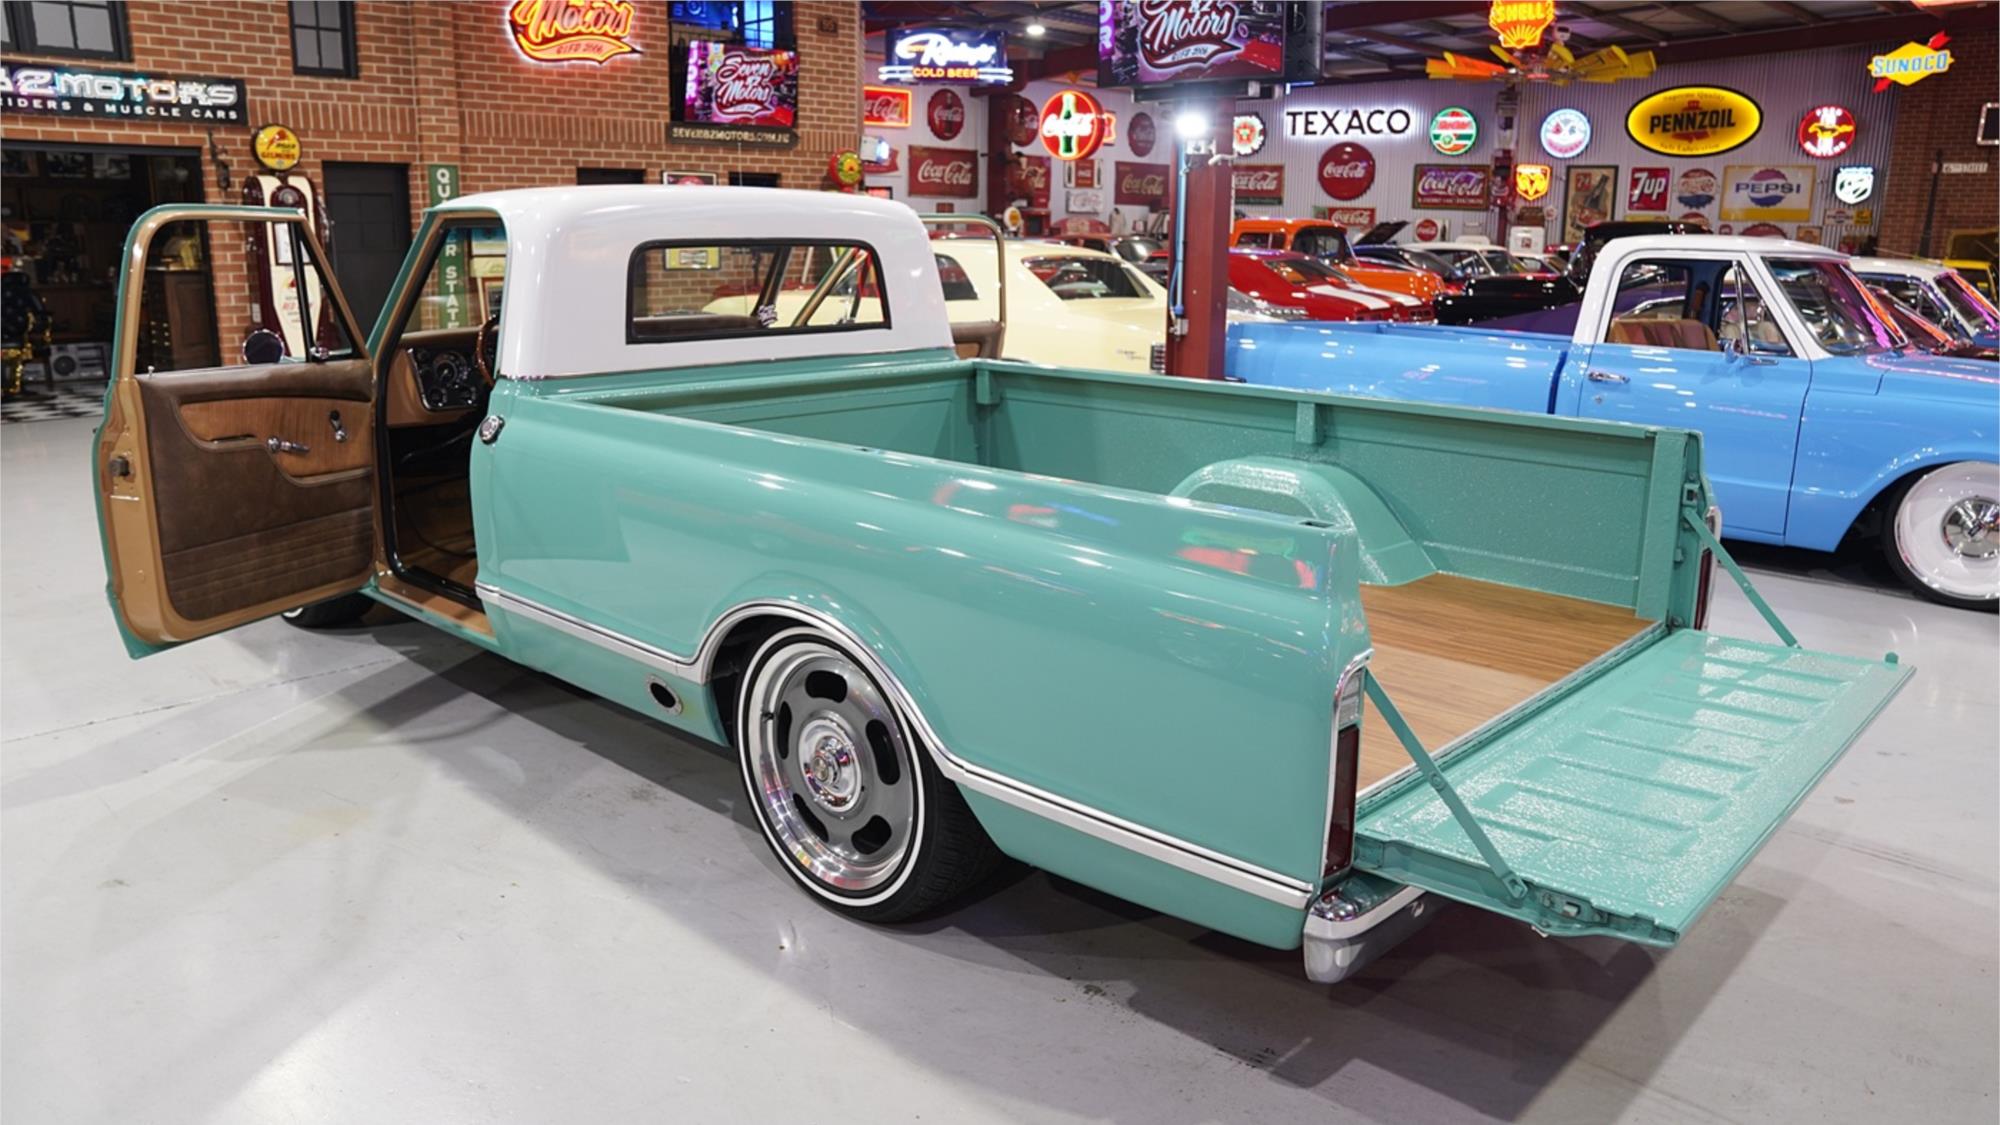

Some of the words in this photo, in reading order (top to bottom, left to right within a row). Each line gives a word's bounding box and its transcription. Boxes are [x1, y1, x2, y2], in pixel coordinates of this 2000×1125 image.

[1496, 2, 1546, 23] SHELL
[1144, 6, 1231, 51] Motors
[717, 54, 771, 82] Seven
[912, 67, 945, 78] COLD
[947, 67, 979, 79] BEER
[1873, 52, 1948, 75] SUNOCO
[717, 80, 770, 104] Motors
[83, 102, 94, 112] &
[105, 104, 181, 117] MUSCLE
[191, 108, 238, 120] CARS
[1286, 109, 1411, 136] TEXACO
[1649, 108, 1736, 134] PENNZOIL
[1735, 182, 1802, 194] PEPSI
